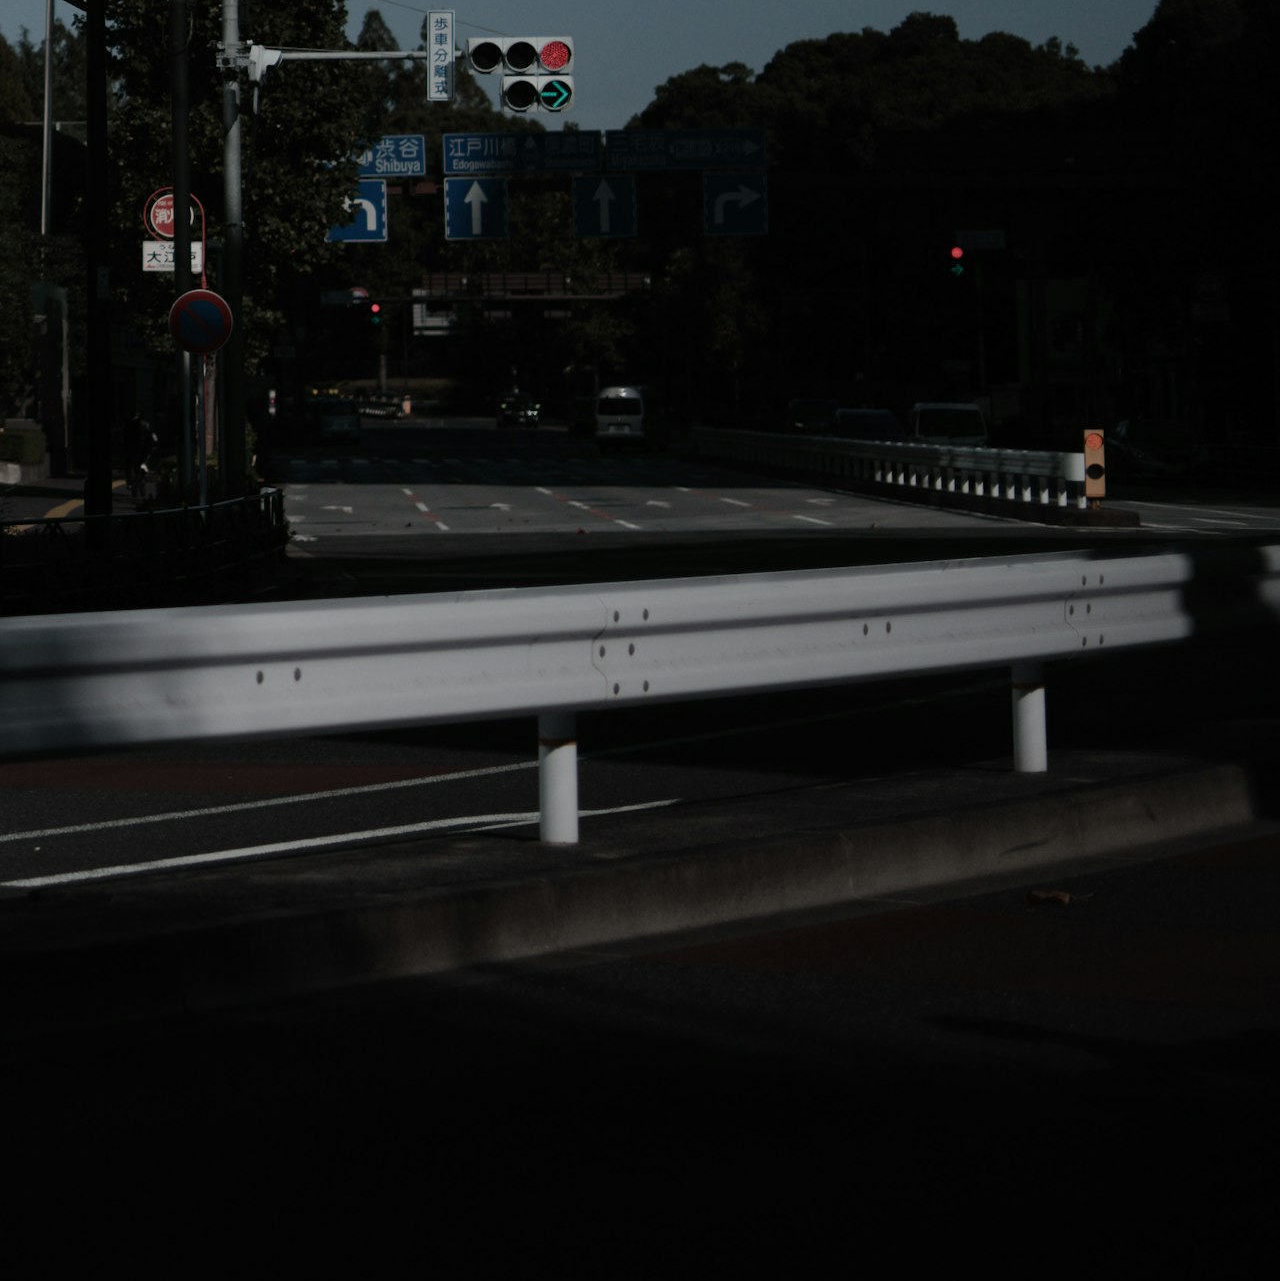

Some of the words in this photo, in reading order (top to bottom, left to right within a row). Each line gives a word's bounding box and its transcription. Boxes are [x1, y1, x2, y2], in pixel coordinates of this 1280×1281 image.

[434, 17, 449, 95] 歩車分離式
[376, 138, 420, 159] 渋谷
[375, 158, 421, 174] Shibuya
